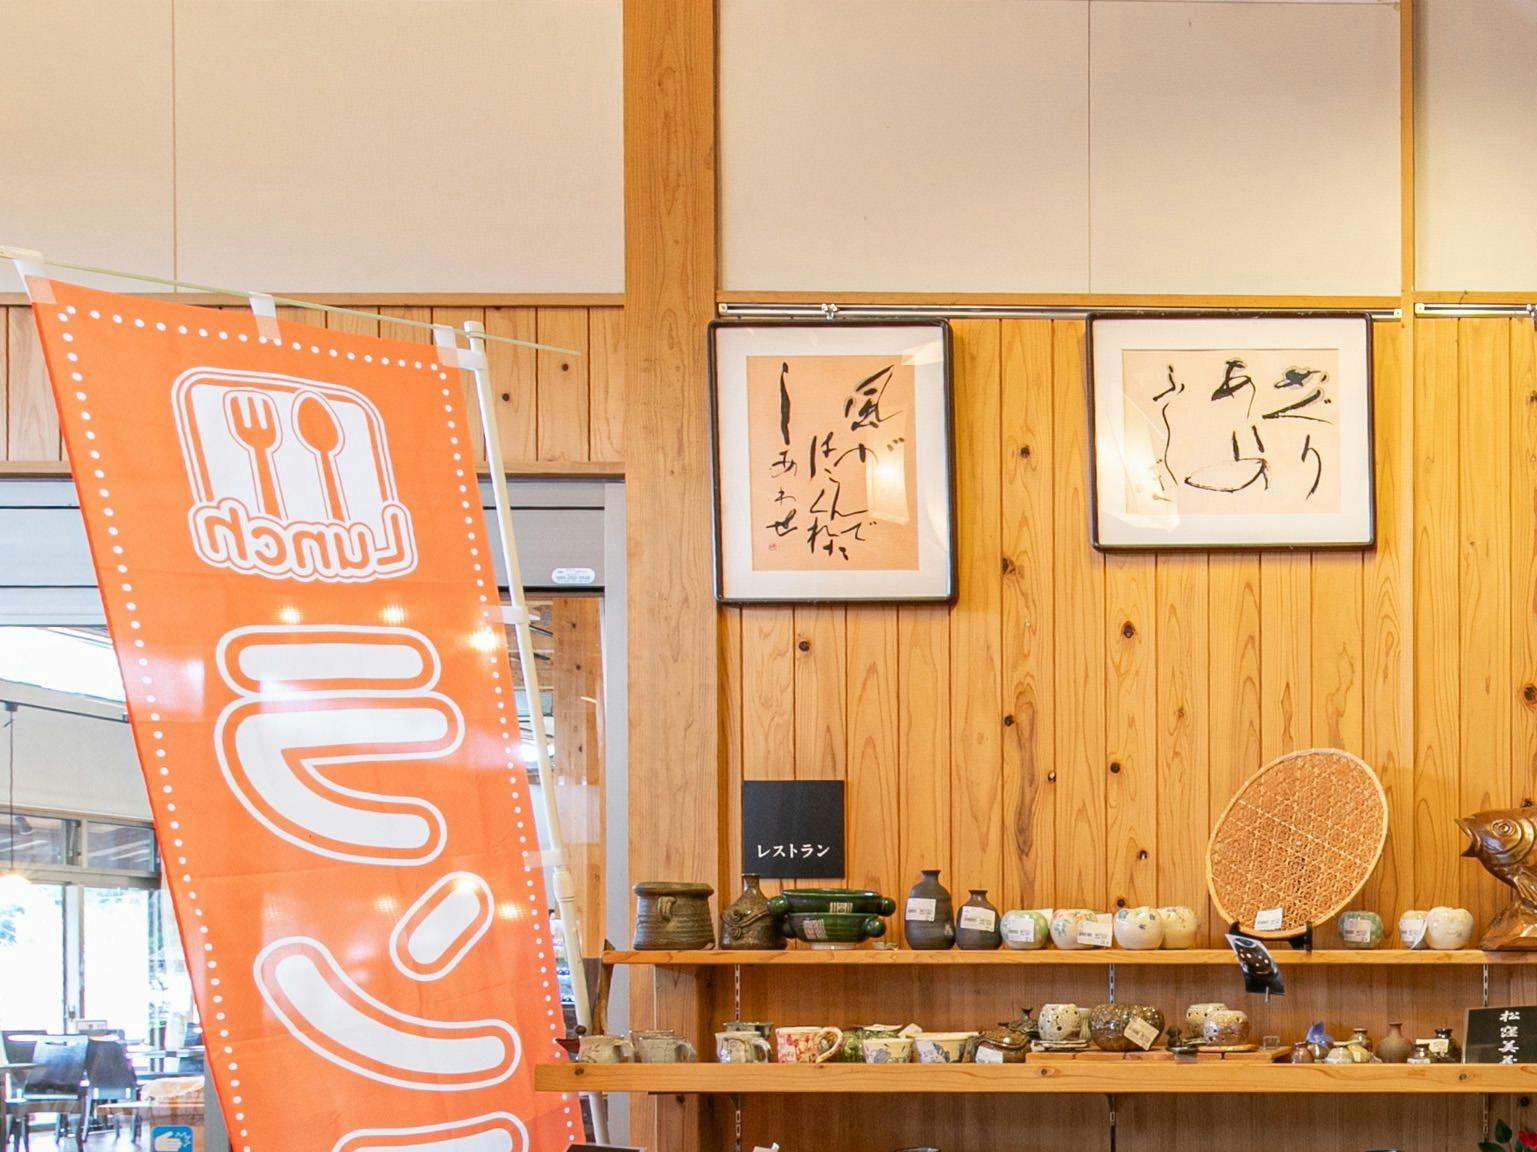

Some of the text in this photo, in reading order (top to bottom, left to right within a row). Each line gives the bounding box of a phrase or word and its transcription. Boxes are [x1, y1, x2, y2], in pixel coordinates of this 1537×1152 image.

[757, 843, 830, 858] レストラン
